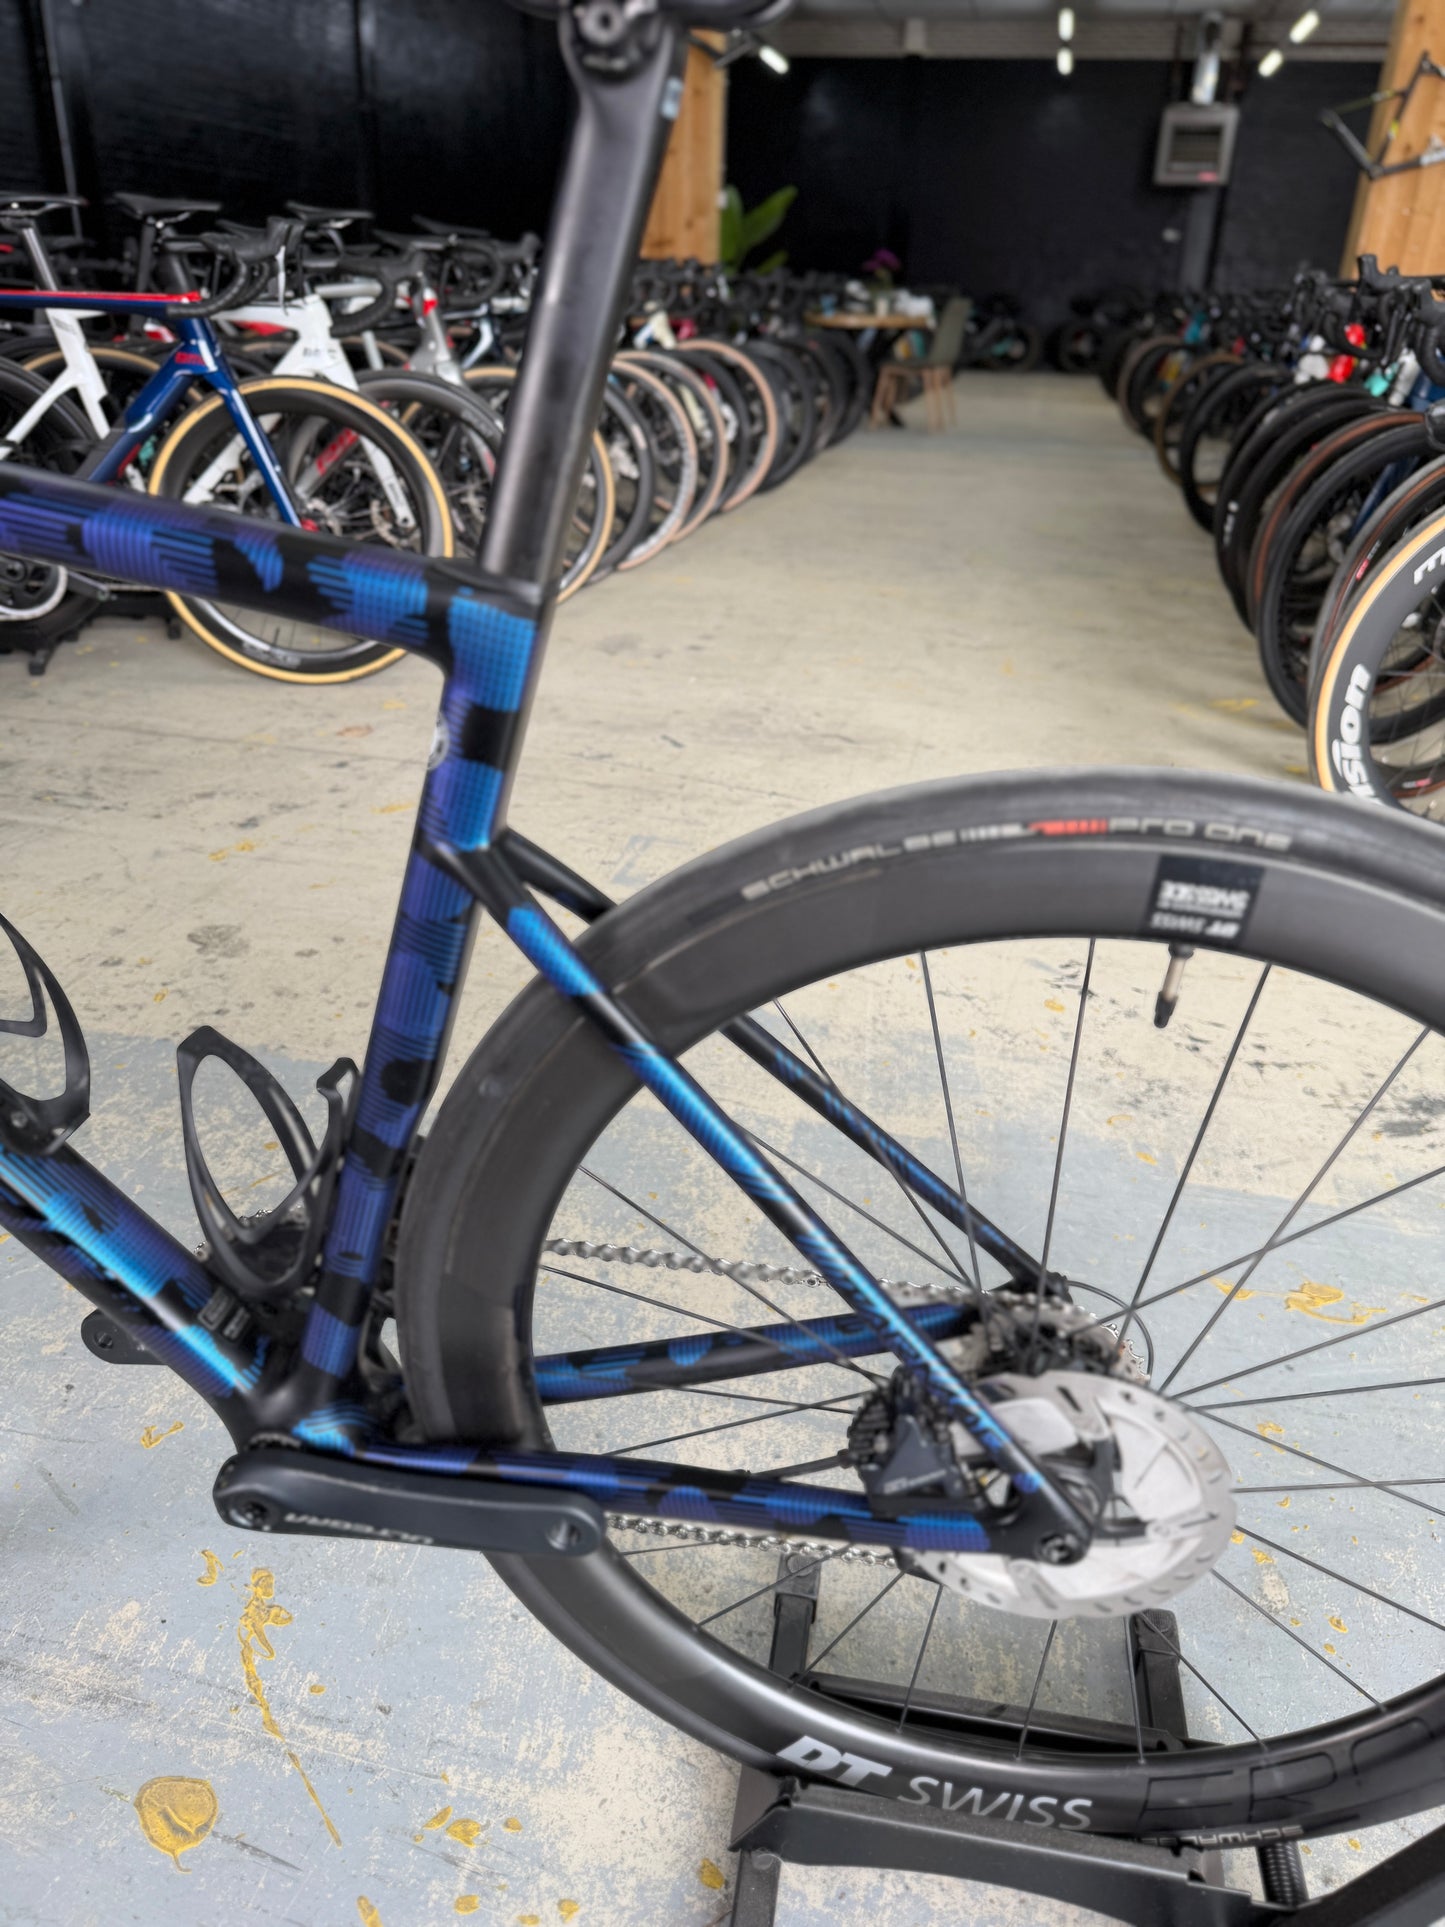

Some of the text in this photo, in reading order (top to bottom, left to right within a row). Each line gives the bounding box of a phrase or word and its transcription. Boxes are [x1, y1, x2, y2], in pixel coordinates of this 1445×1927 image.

[741, 829, 957, 900] SCHWALBE
[776, 1735, 1093, 1830] DT SWISS
